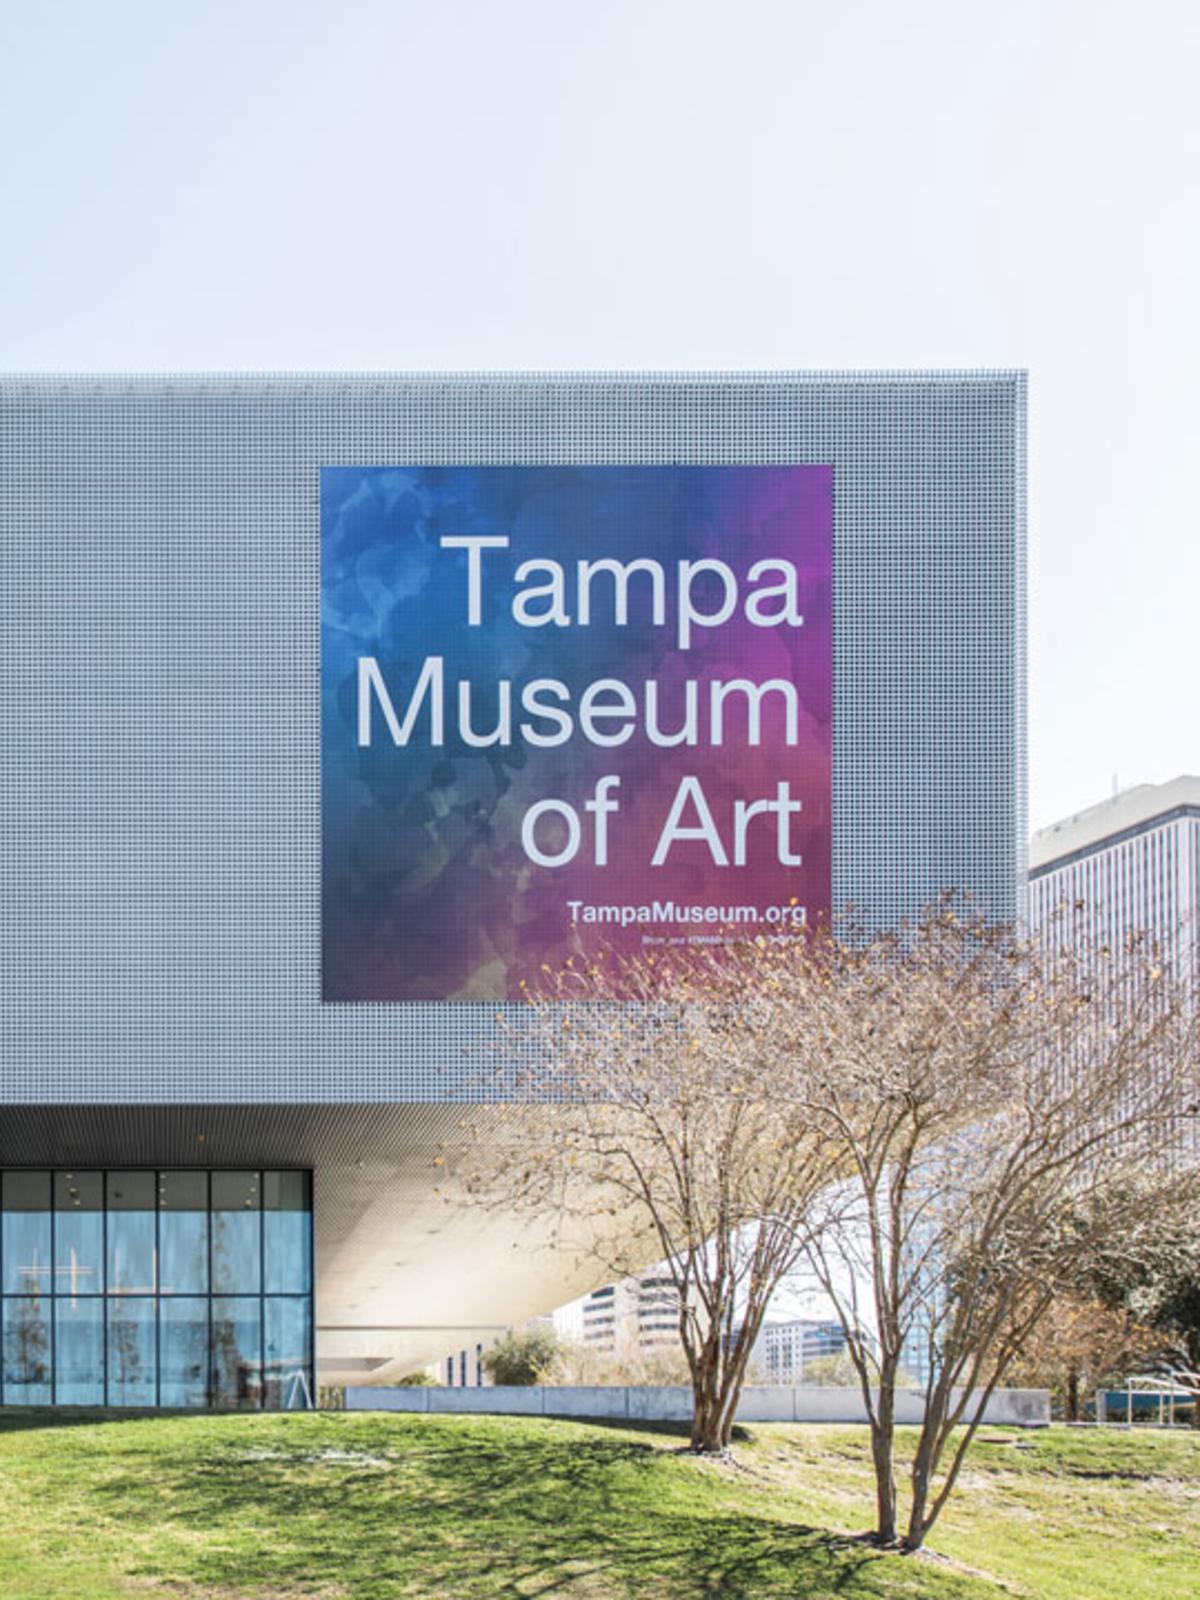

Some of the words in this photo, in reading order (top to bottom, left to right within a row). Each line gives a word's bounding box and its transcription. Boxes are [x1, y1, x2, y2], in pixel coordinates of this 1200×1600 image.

[441, 537, 803, 648] Tampa
[358, 657, 798, 747] Museum
[522, 776, 619, 867] of
[652, 776, 802, 866] Art
[568, 902, 806, 926] TampaMuseum.org
